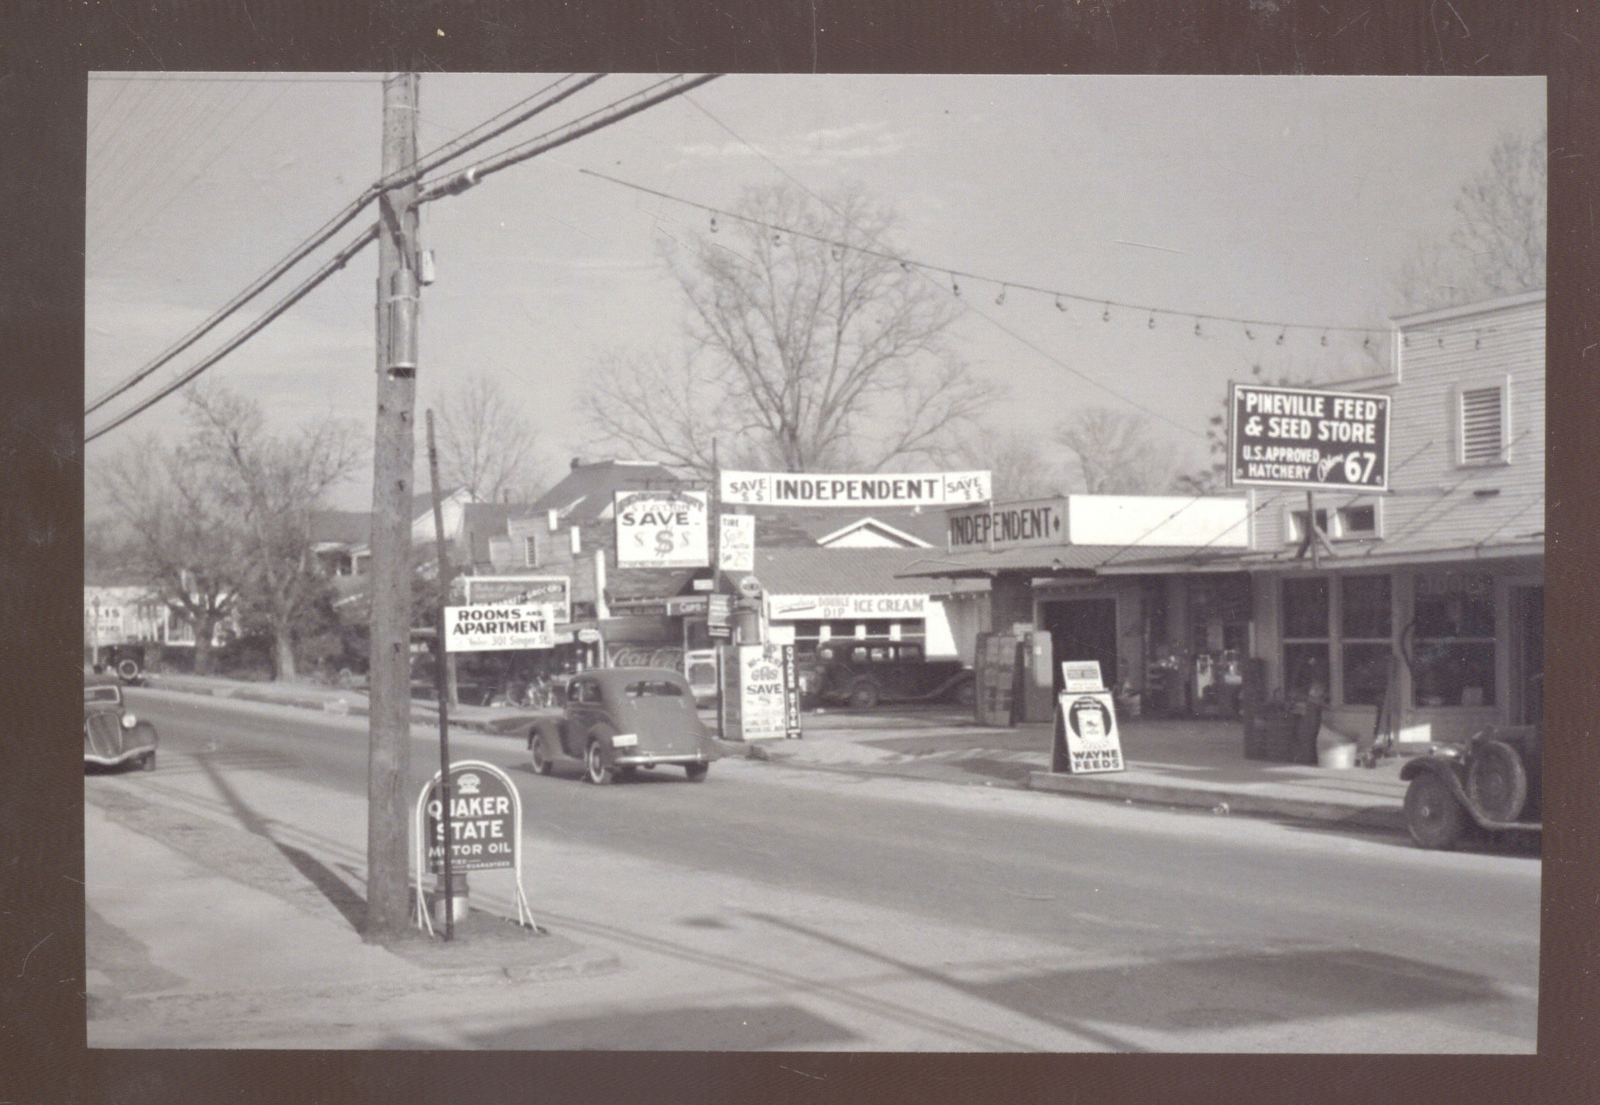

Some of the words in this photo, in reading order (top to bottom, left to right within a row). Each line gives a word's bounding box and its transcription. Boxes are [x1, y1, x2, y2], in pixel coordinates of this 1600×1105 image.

[1246, 392, 1325, 417] PINEVILLE
[1333, 398, 1377, 421] FEED
[1244, 415, 1263, 437] &
[1268, 417, 1312, 439] SEED
[1317, 420, 1376, 444] STORE
[1248, 463, 1312, 480] HATCHERY
[1344, 452, 1376, 483] 67
[729, 478, 767, 494] SAVE
[775, 479, 939, 501] INDEPENDENT
[947, 477, 982, 494] SAVE
[622, 512, 690, 526] SAVE
[951, 507, 1051, 546] INDEPENDENT
[654, 526, 675, 558] $
[823, 608, 845, 618] DIP
[854, 600, 873, 612] ICE
[877, 599, 924, 613] CREAM
[457, 608, 522, 622] ROOMS
[452, 619, 547, 635] APARTMENT
[751, 666, 779, 681] GAS
[746, 683, 782, 695] SAVE
[1072, 749, 1119, 760] WAYNE
[1074, 760, 1120, 770] FEEDS
[436, 820, 504, 841] STATE
[428, 843, 483, 857] MTOR
[488, 842, 511, 854] OIL
